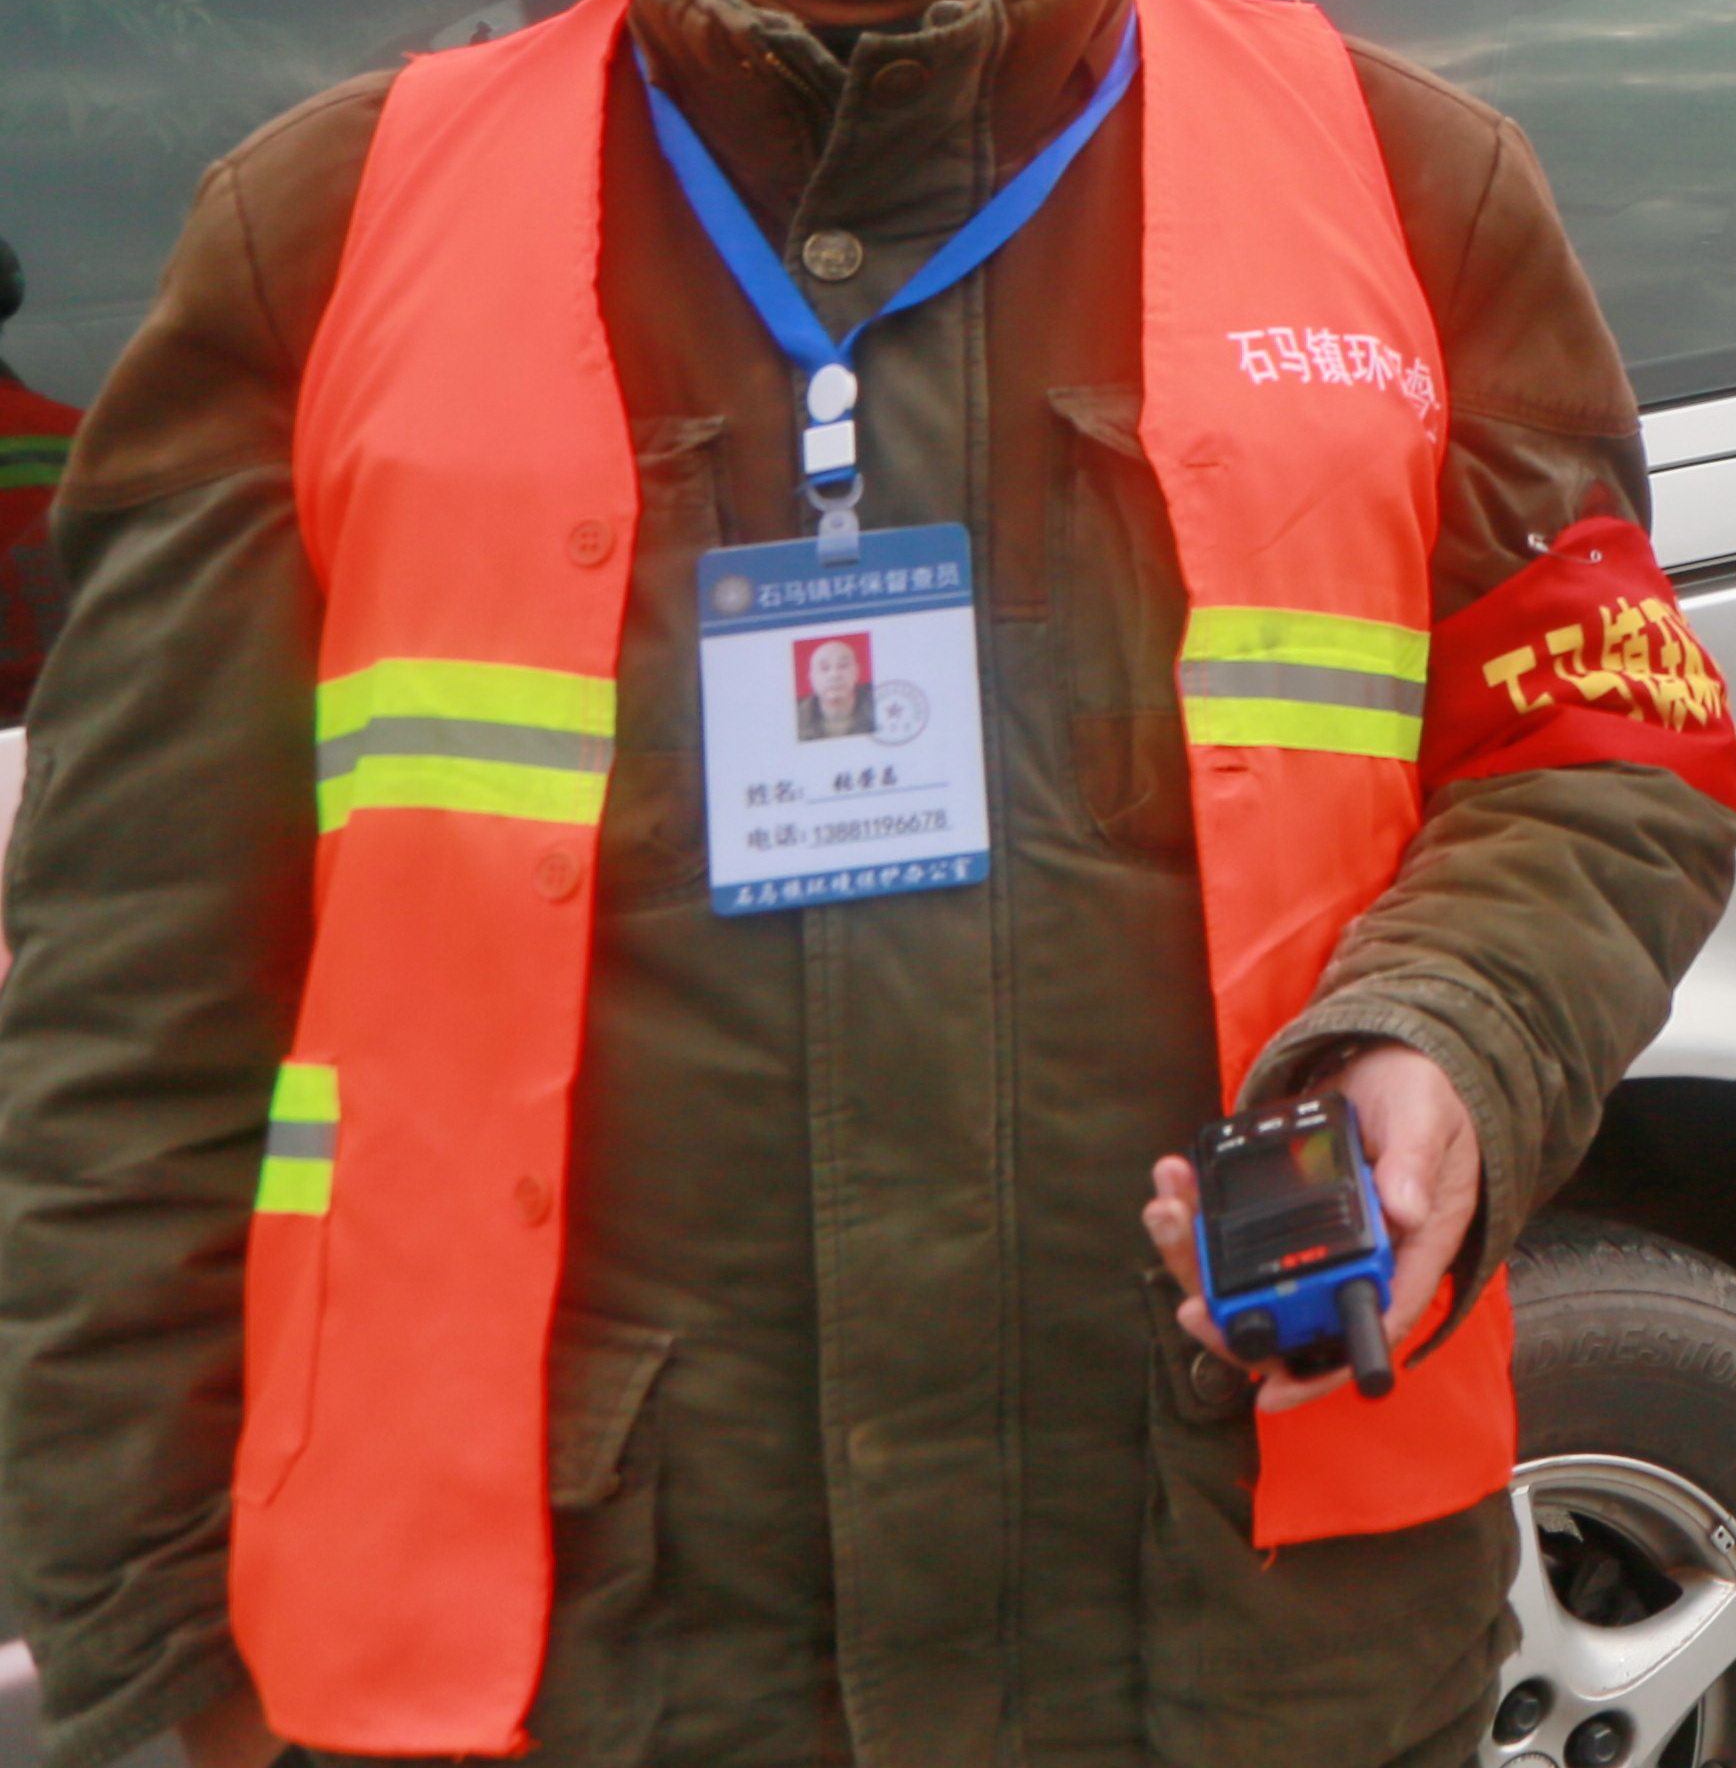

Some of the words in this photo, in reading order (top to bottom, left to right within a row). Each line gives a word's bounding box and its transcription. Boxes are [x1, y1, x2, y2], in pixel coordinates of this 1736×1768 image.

[757, 561, 960, 608] 石马镇环保督查员
[733, 856, 973, 907] 石马镇环境保护办公室
